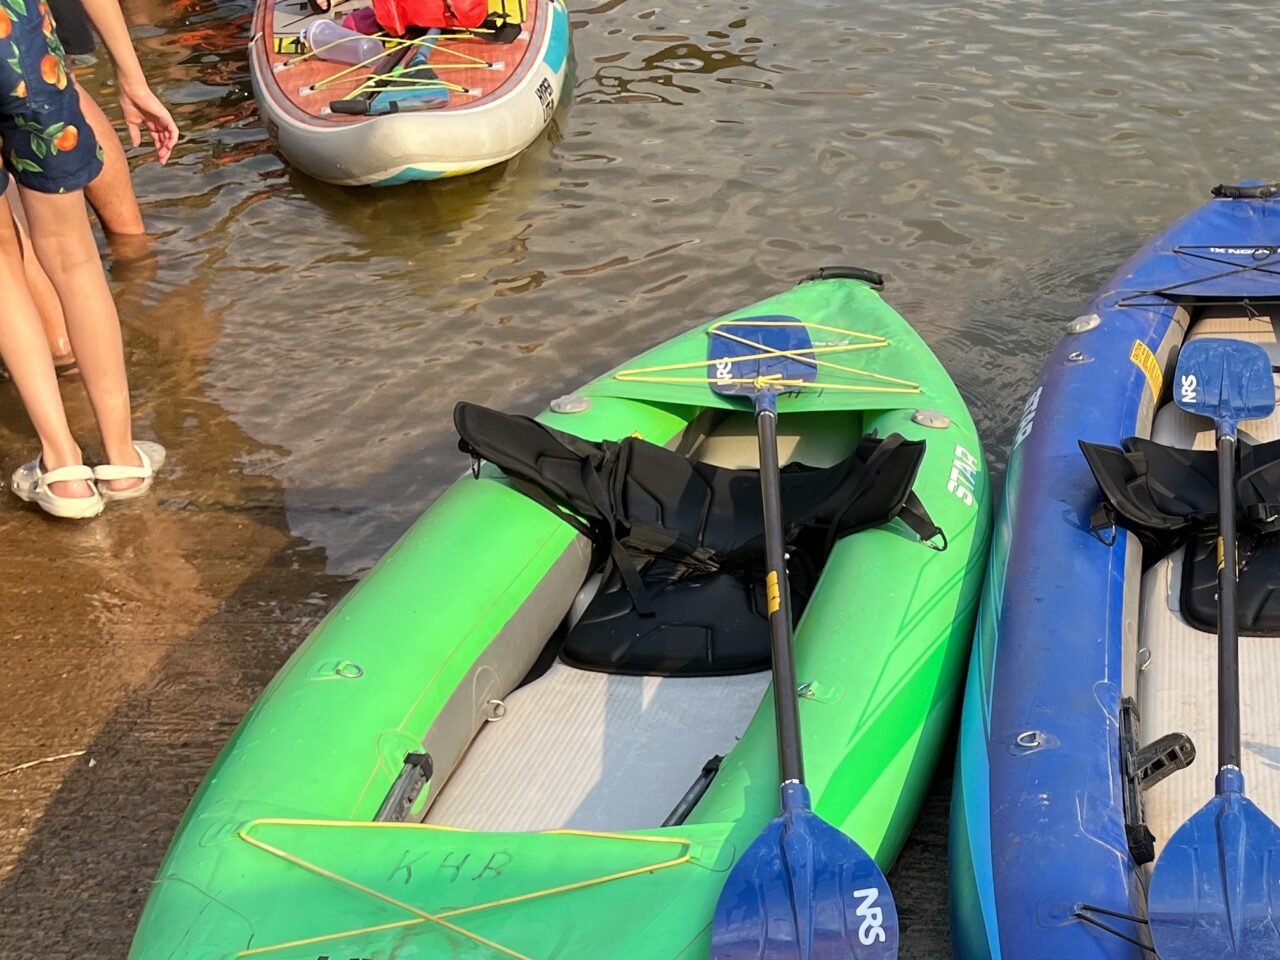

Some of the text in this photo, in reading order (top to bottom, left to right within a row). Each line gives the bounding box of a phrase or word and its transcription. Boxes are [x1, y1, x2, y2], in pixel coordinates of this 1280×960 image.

[1181, 374, 1197, 403] NRS
[946, 444, 978, 507] STAR
[387, 850, 513, 885] KHB
[853, 887, 886, 945] NRS
